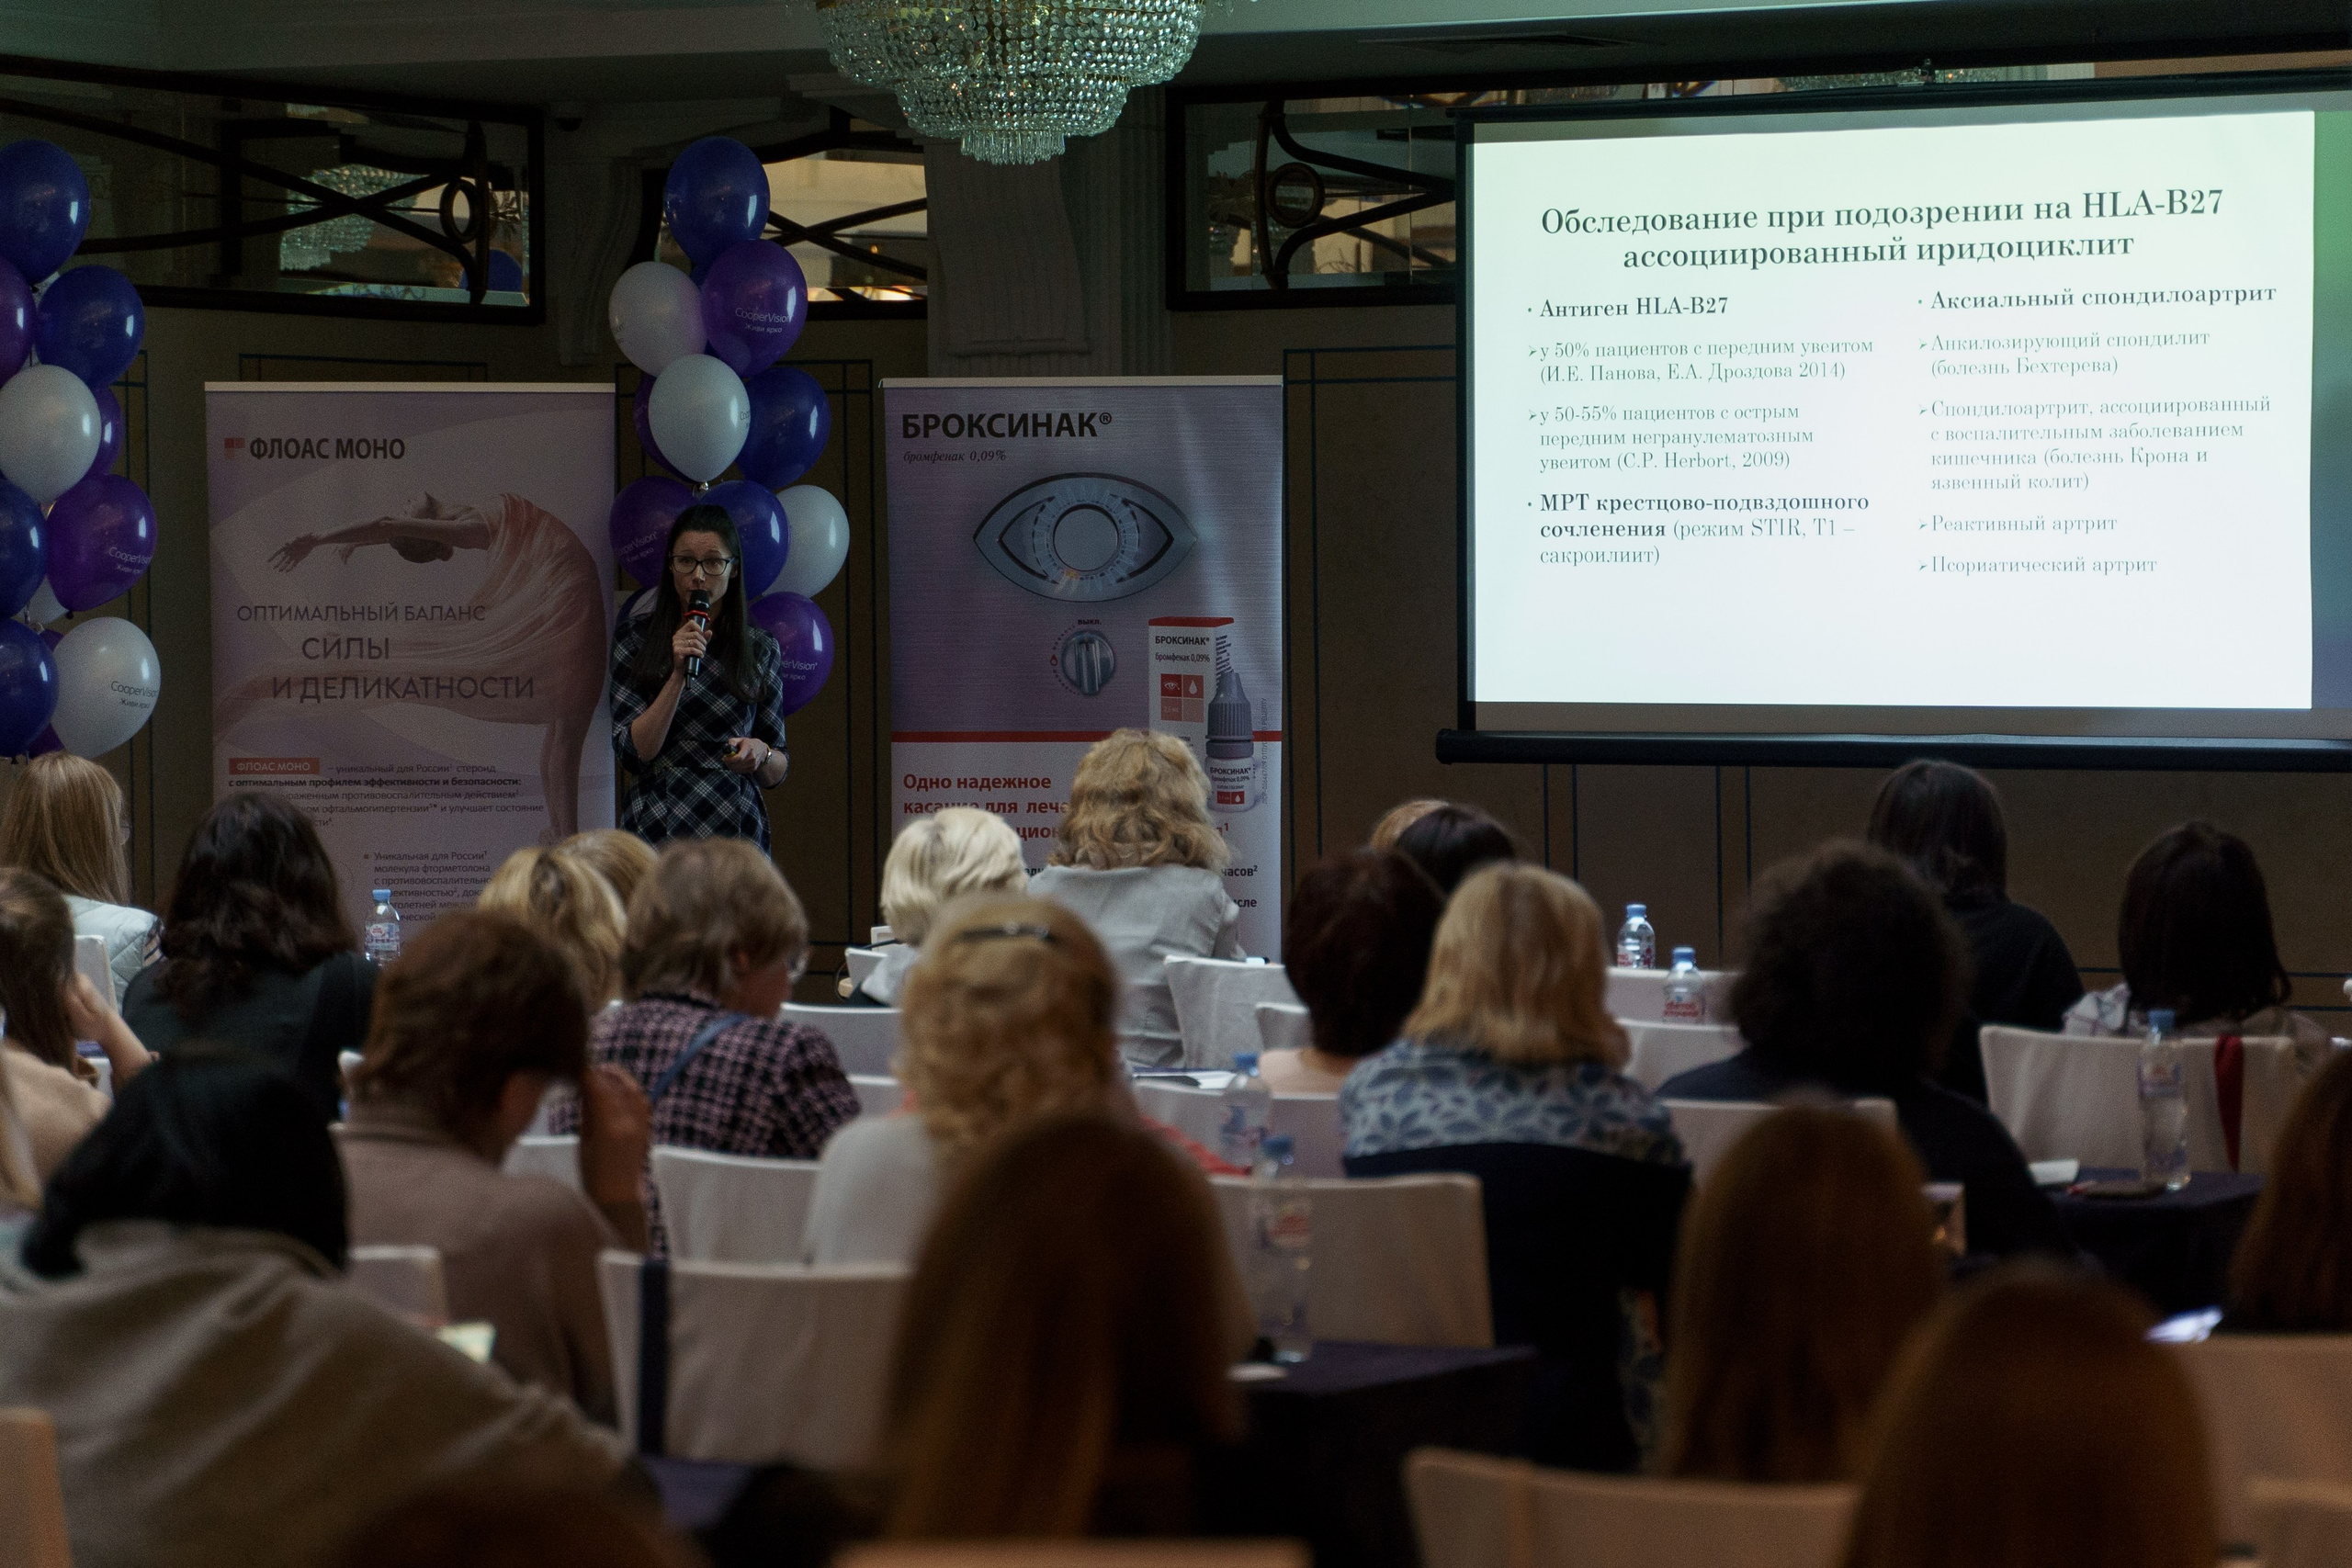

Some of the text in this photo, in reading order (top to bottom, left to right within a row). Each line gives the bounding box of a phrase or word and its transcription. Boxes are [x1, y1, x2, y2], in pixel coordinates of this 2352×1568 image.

[1541, 187, 2224, 236] Обследование при подозрении на HLA-B27
[1623, 235, 2135, 272] ассоциированный иридоциклит
[1539, 295, 1729, 318] Антиген HLA-B27
[1929, 287, 2278, 310] Аксиальный спондилоартрит
[744, 322, 764, 333] Живи
[1554, 341, 1590, 358] 50%
[1595, 344, 1689, 359] пациентов
[1707, 342, 1795, 359] передним
[1800, 341, 1873, 358] увеитом
[1931, 332, 2211, 354] Анкилозирующий спондилит
[1540, 361, 1846, 386] (И.Е. Панова, Е.А. Дроздова 2014)
[1931, 355, 2119, 378] (болезнь Бехтерева)
[1555, 404, 1618, 423] 50-55%
[1623, 408, 1715, 423] пациентов
[1734, 407, 1799, 423] острым
[1930, 395, 2270, 420] Спондилоартрит, ассоциированный
[1540, 431, 1814, 451] передним негранулематозным
[1945, 427, 2103, 442] воспалительным
[2109, 422, 2244, 439] заболеванием
[249, 436, 406, 460] ФЛОАС МОНО
[903, 448, 1007, 463] бромфенак 0,09%
[1931, 446, 2208, 468] кишечника (болезнь Крона и
[1539, 457, 1611, 474] увеитом
[1664, 451, 1736, 469] Herbort,
[1742, 450, 1791, 470] 2009)
[1931, 472, 2089, 491] язвенный колит)
[1539, 492, 1870, 515] МРТ крестцово-подвздошного
[1539, 524, 1667, 538] сочленения
[1672, 519, 1744, 541] (режим
[1750, 517, 1806, 538] STIR,
[1932, 514, 2118, 536] Реактивный артрит
[1539, 545, 1660, 568] сакроилиит)
[1932, 555, 2158, 577] Псориатический артрит
[236, 602, 486, 622] ОПТИМАЛЬНЫЙ БАЛАНС
[301, 637, 390, 660] СИЛЫ
[1155, 653, 1210, 662] бромфенак 0,09%
[272, 677, 536, 704] И ДЕЛИКАТНОСТИ
[236, 761, 275, 773] ФЛОАС
[277, 761, 311, 771] МОНО
[336, 764, 394, 774] уникальный
[397, 765, 413, 773] для
[457, 765, 496, 773] стероид
[236, 779, 307, 787] оптимальным
[309, 777, 361, 788] профилем
[364, 776, 440, 787] эффективности
[451, 776, 522, 786] безопасности:
[903, 774, 1051, 792] Одно надежное
[342, 790, 462, 800] противовоспалительным
[448, 803, 493, 814] улучшает
[495, 803, 545, 812] состояние
[984, 800, 1018, 816] для
[374, 852, 429, 861] Уникальная
[431, 852, 448, 861] для
[374, 863, 491, 874] молекула фторметолона
[381, 877, 492, 886] противовоспалительно
